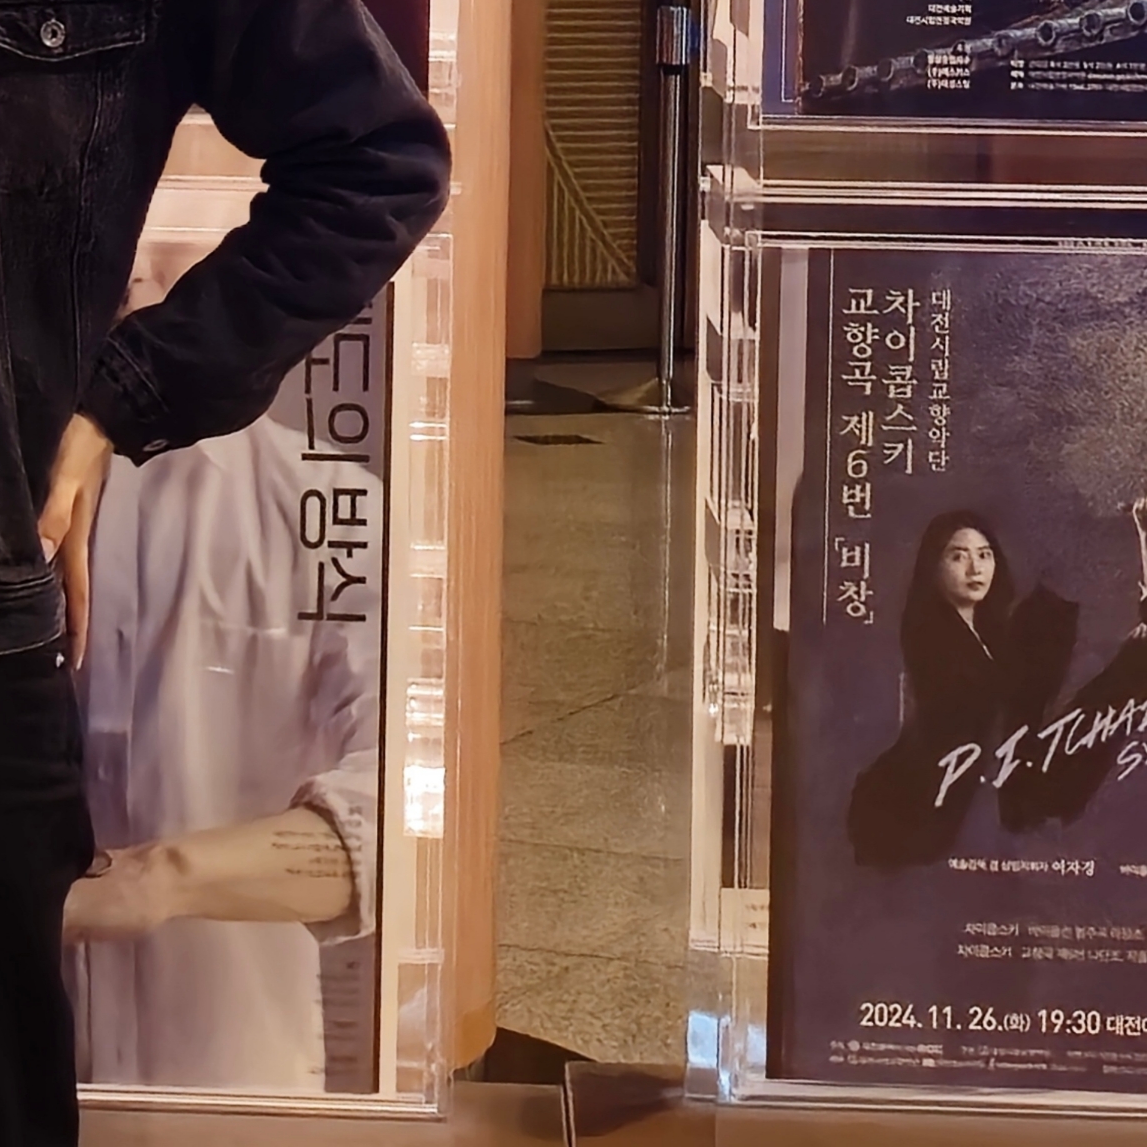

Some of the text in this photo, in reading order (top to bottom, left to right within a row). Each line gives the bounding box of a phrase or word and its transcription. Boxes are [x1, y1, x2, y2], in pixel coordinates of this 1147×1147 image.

[840, 287, 880, 395] 교향곡
[880, 287, 921, 475] 차이콥스키
[926, 288, 952, 473] 대전시립교향악단
[296, 302, 373, 623] 도의 방식
[839, 410, 875, 519] 제6번
[859, 1002, 923, 1029] 2024.
[928, 1004, 962, 1030] 11.
[1037, 1008, 1101, 1035] 19:30
